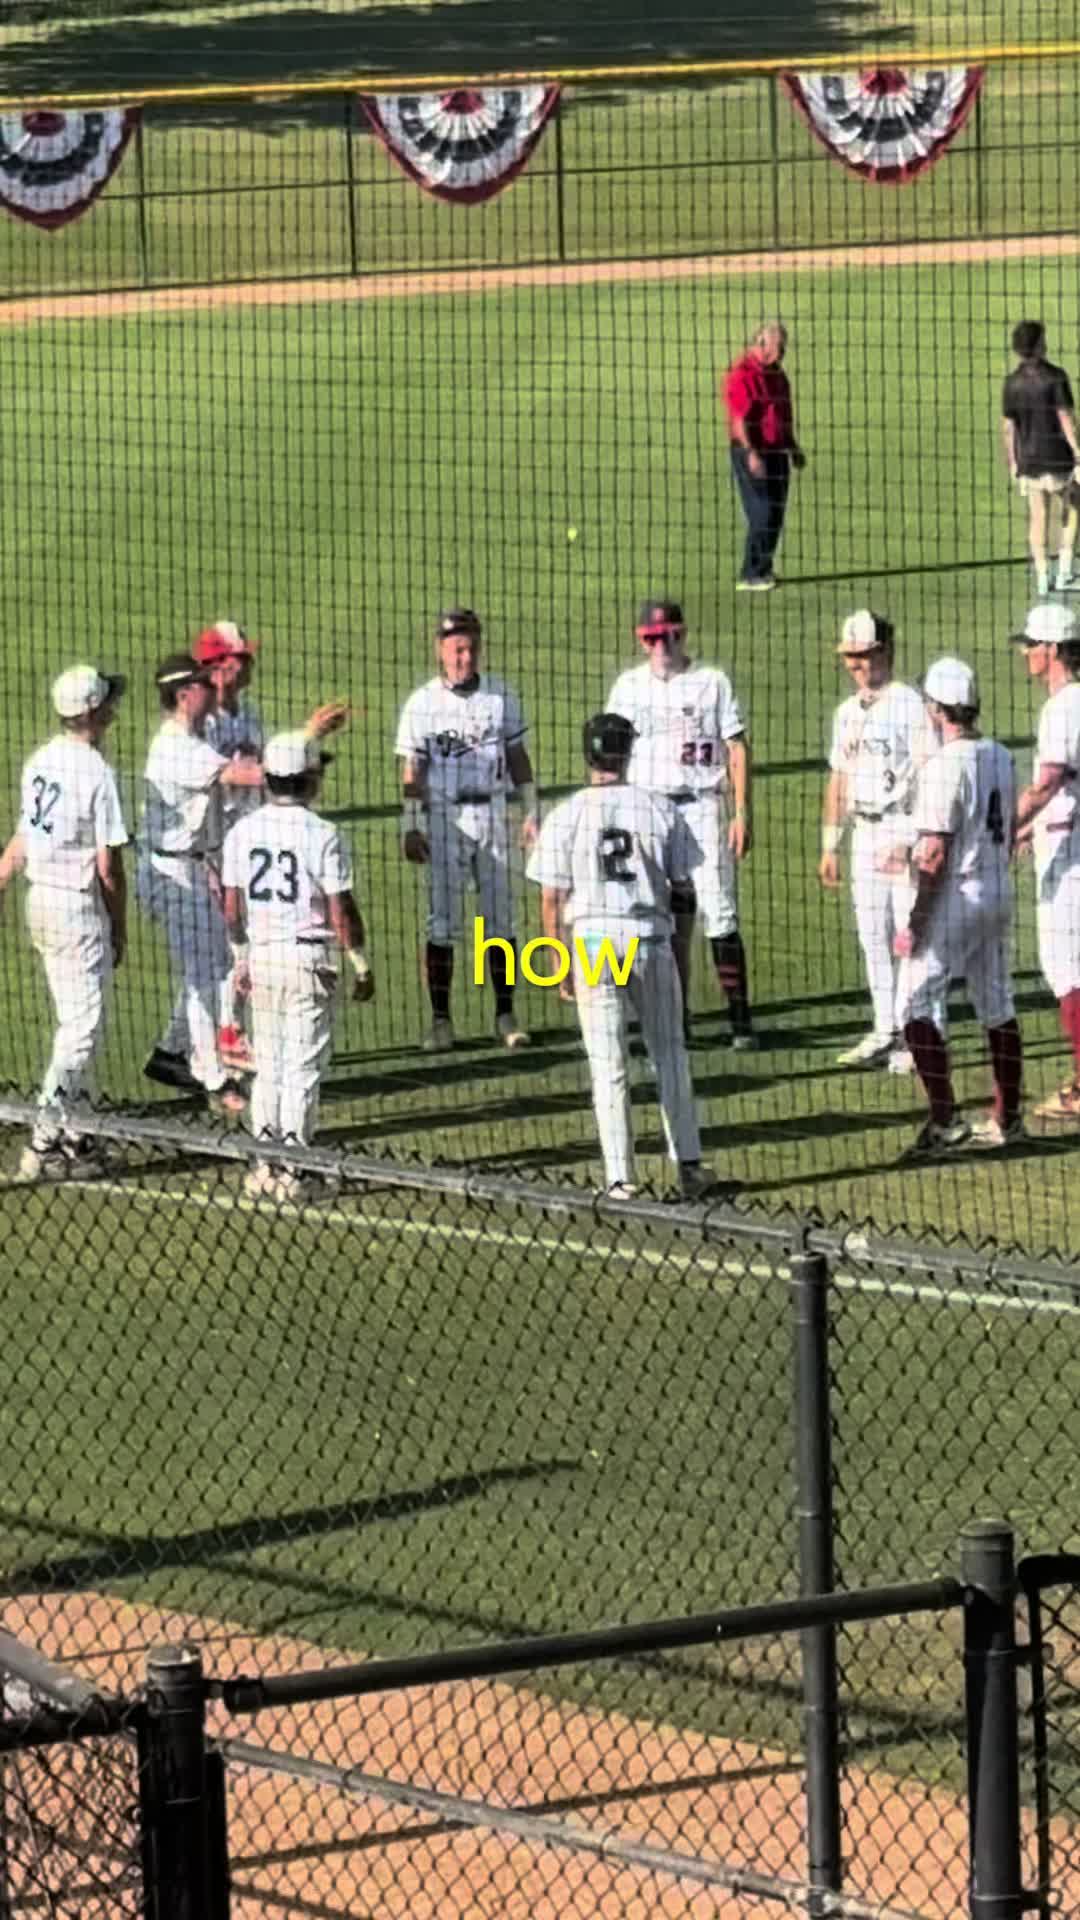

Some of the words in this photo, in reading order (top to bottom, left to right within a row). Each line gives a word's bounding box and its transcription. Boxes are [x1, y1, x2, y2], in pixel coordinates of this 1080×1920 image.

[680, 741, 714, 767] 23
[882, 768, 897, 793] 3
[30, 774, 61, 835] 32
[986, 787, 1005, 845] 4
[248, 847, 299, 905] 23
[598, 828, 637, 882] 2
